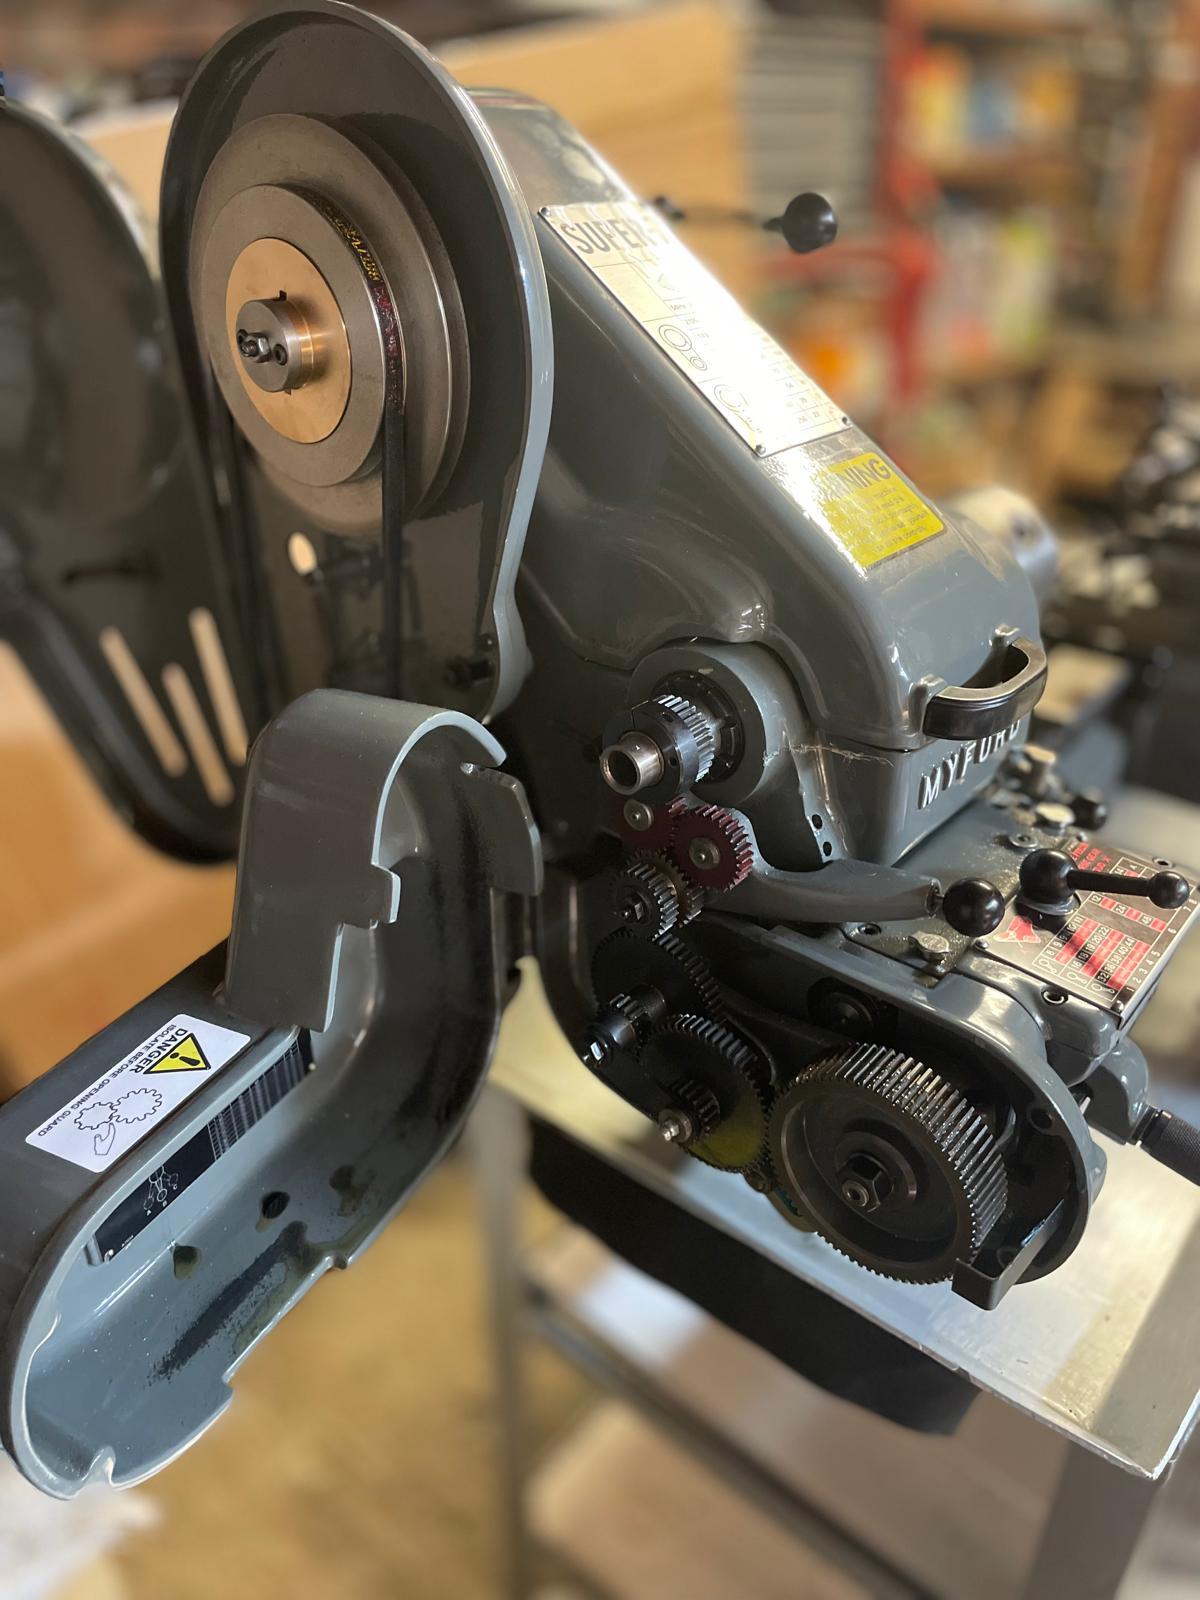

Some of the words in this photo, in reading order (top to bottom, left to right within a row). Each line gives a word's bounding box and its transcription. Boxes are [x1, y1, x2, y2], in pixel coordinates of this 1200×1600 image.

[1116, 905, 1127, 914] 24
[1085, 943, 1096, 951] 19
[1098, 926, 1110, 936] 22
[1145, 958, 1154, 966] 4
[1097, 972, 1109, 982] 32
[129, 1027, 188, 1074] DANGER
[142, 1024, 177, 1051] ISOLATE
[109, 1051, 144, 1078] BEFORE
[70, 1079, 111, 1110] OPENING
[38, 1109, 72, 1137] GUARD
